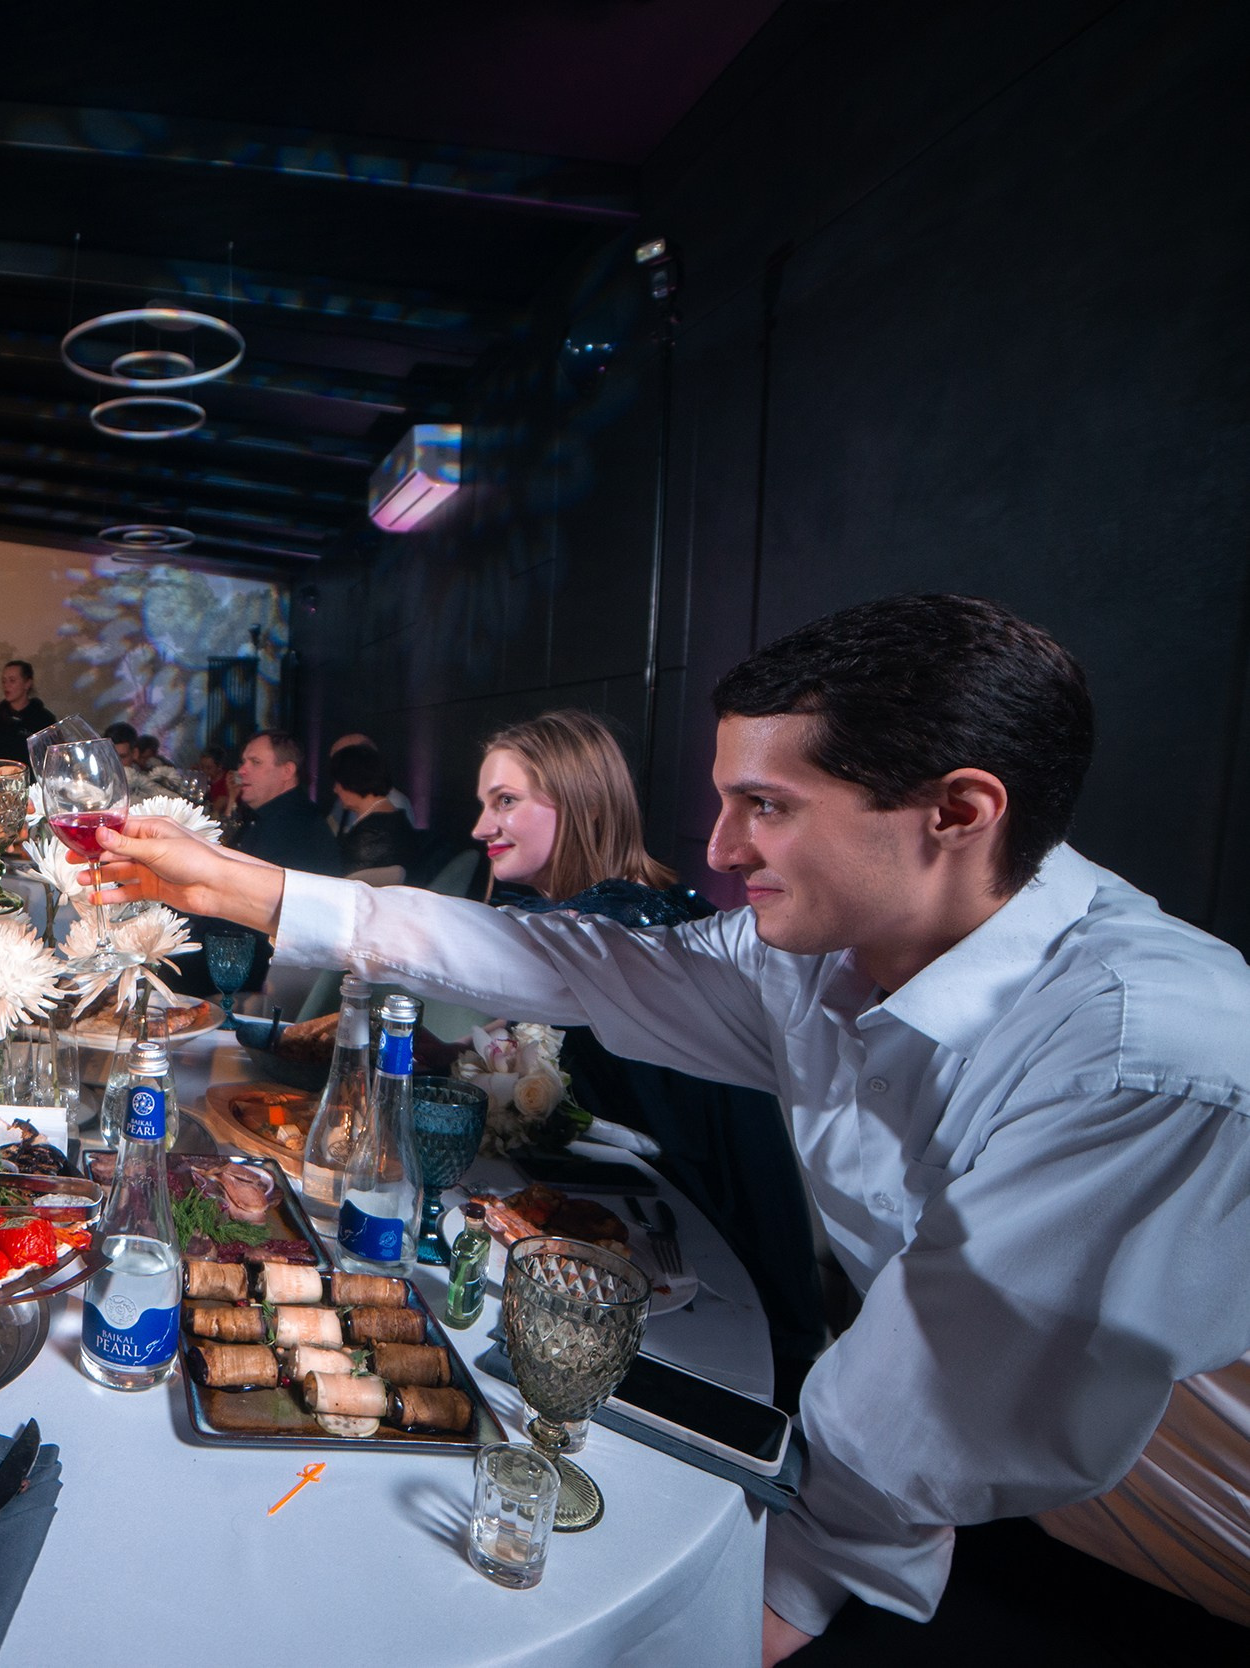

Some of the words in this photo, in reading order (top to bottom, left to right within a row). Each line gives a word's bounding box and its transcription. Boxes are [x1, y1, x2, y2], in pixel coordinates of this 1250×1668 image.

[126, 1122, 157, 1136] PEARL
[130, 1118, 153, 1127] BAIKAL
[102, 1329, 135, 1345] BAIKAL
[96, 1335, 141, 1358] PEARL
